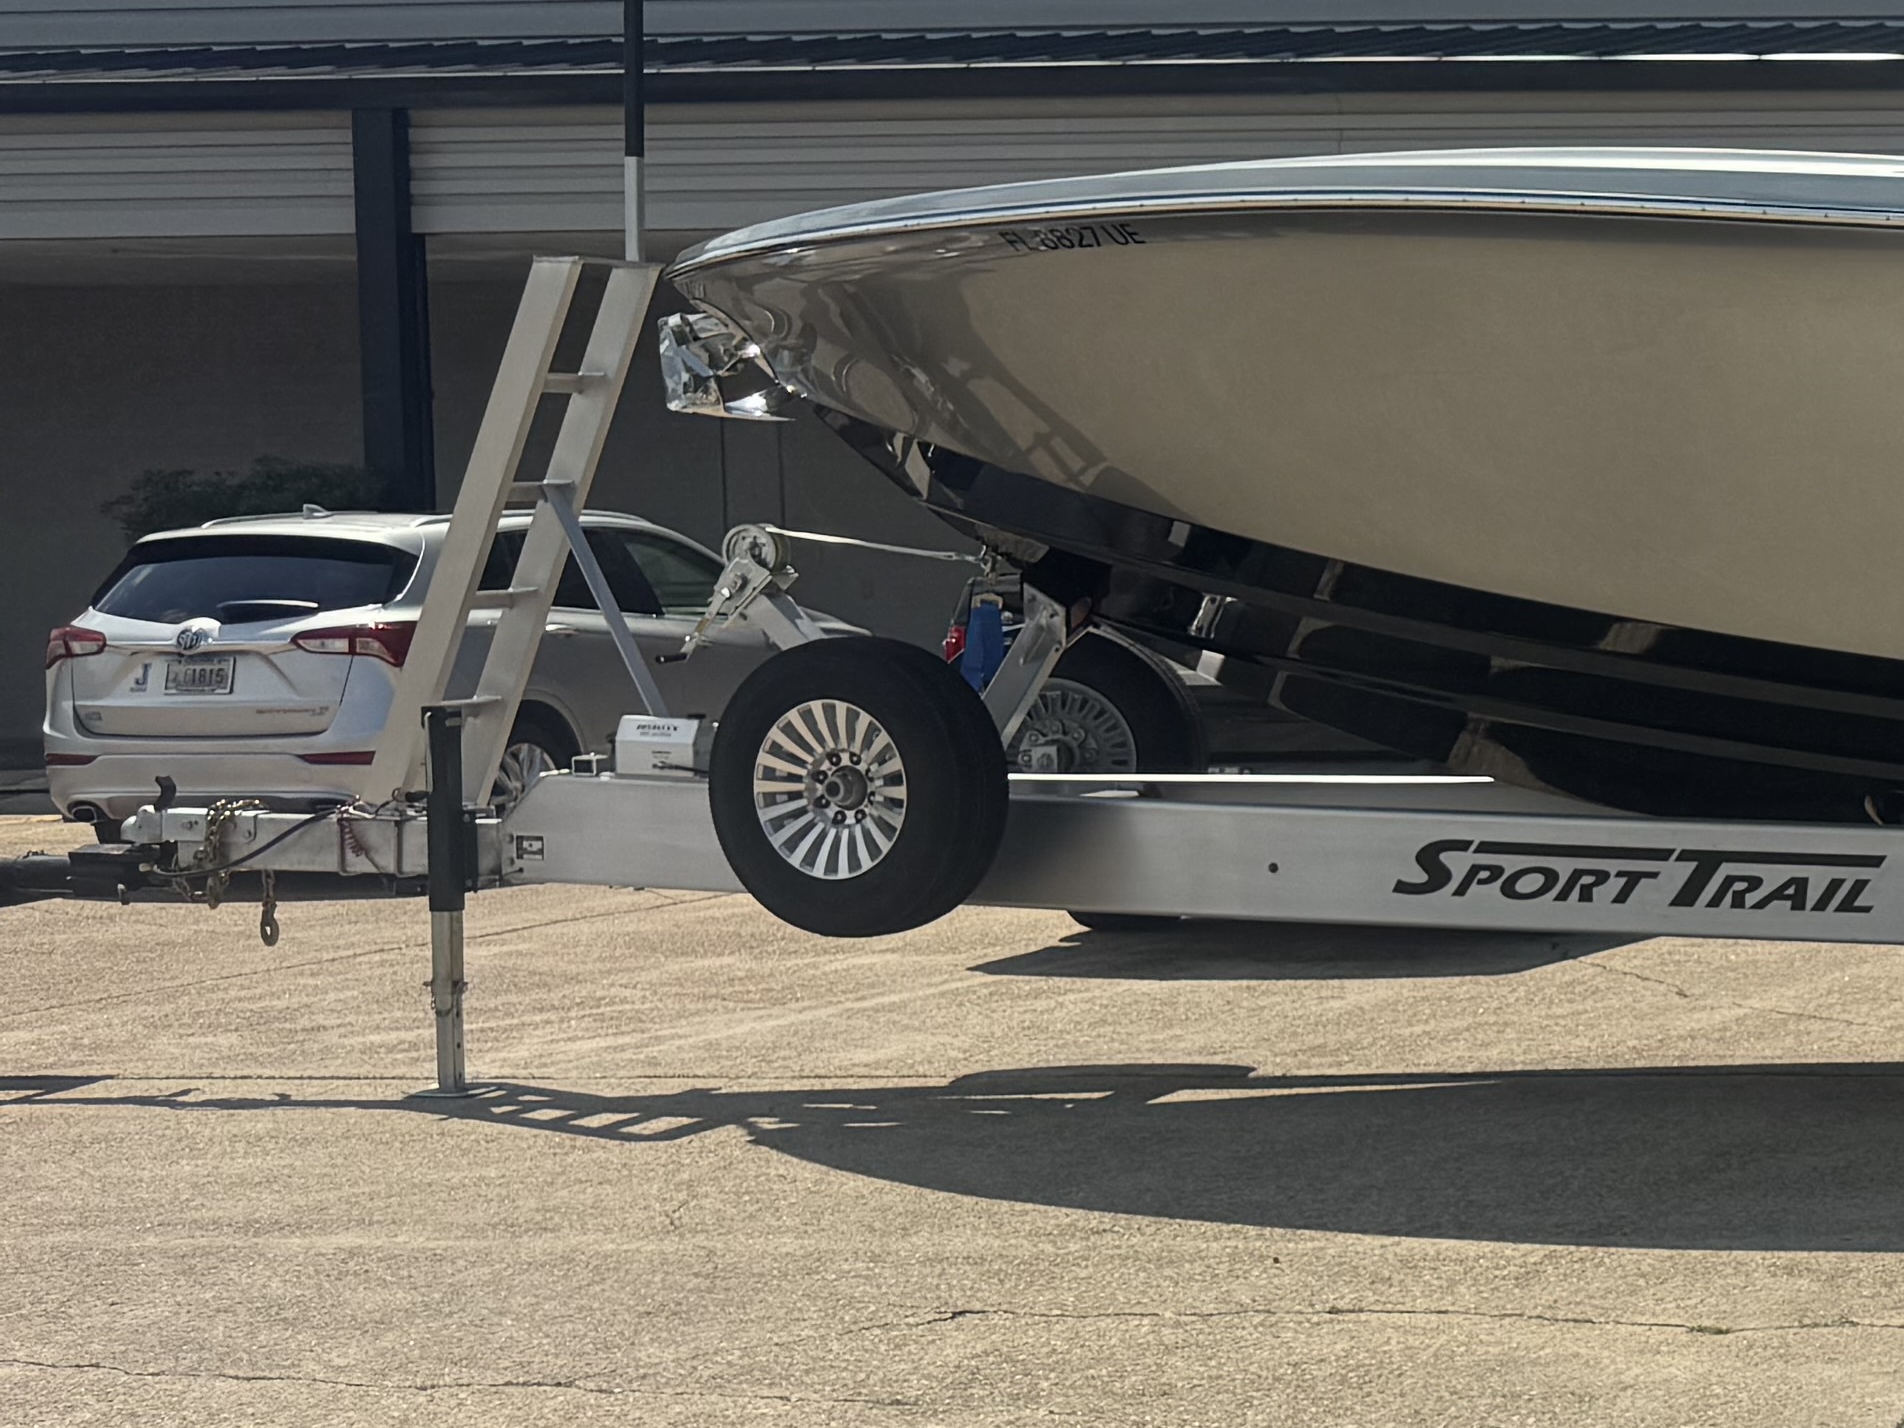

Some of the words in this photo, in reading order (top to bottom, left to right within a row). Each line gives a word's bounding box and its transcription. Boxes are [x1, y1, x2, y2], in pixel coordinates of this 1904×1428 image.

[998, 229, 1039, 253] FL
[1099, 222, 1147, 247] UE
[1391, 837, 1675, 906] SPORT
[1667, 847, 1888, 914] TRAIL
